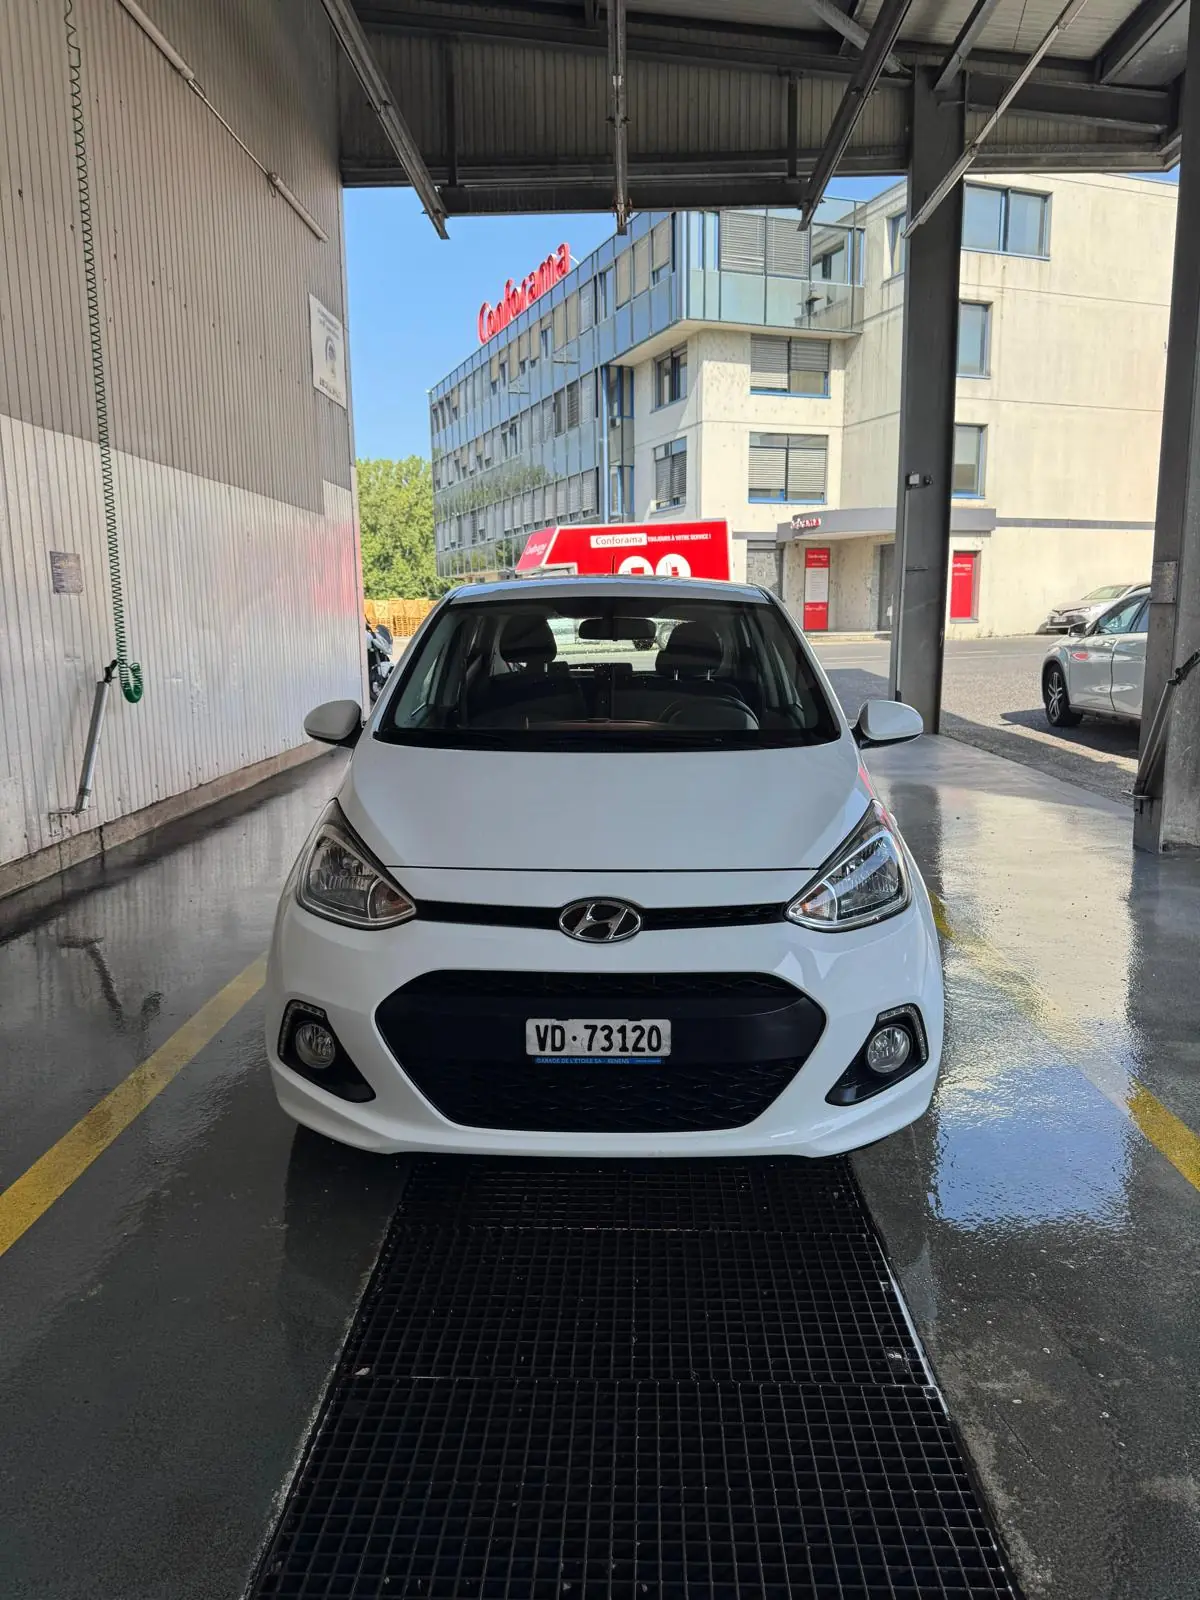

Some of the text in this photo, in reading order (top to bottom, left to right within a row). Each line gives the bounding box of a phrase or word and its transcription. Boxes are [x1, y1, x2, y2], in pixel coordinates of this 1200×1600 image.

[478, 242, 570, 344] Conforama
[595, 535, 643, 546] Conforama
[535, 1024, 566, 1052] VD
[584, 1024, 662, 1052] 73120
